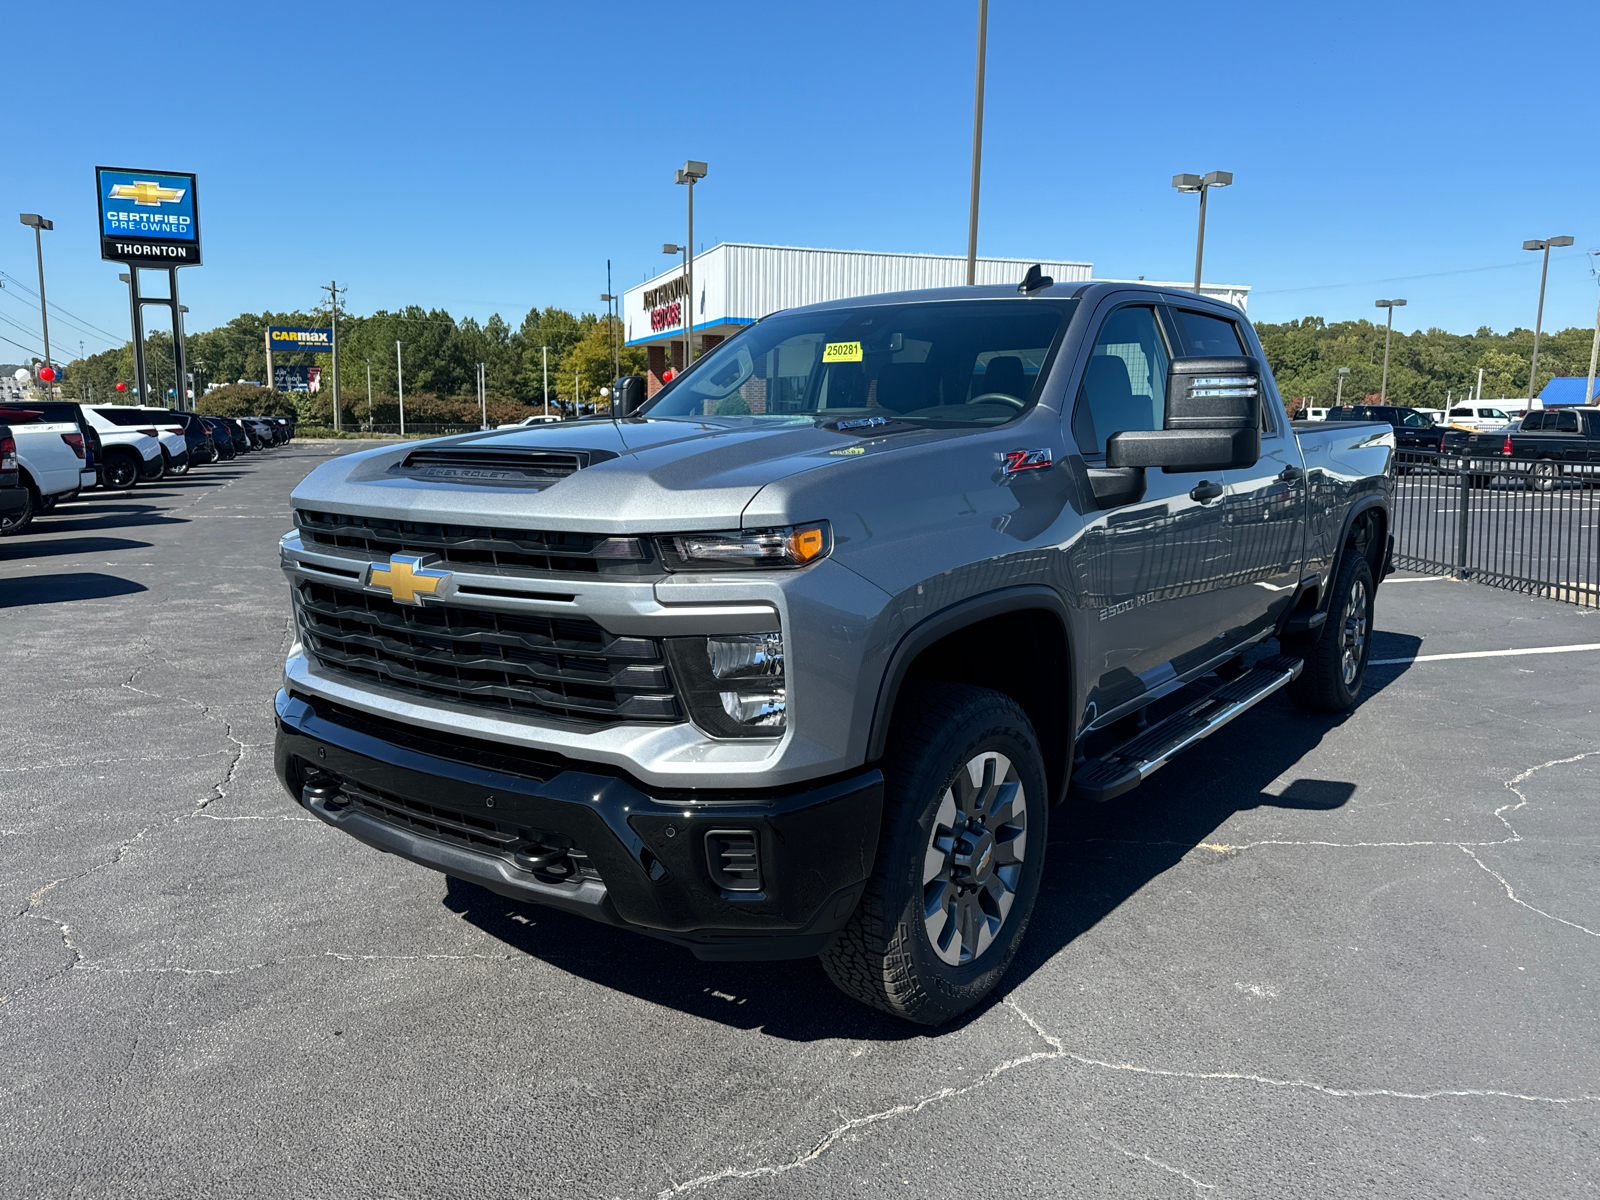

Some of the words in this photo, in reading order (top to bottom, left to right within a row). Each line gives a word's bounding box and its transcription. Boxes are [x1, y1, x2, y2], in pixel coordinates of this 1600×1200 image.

[107, 211, 190, 225] CERTIFIED
[112, 221, 187, 233] PRE-OWNED
[116, 243, 187, 257] THORNTON
[827, 344, 858, 356] 250281
[427, 469, 509, 478] CHEVROLET
[1098, 598, 1135, 621] 2500
